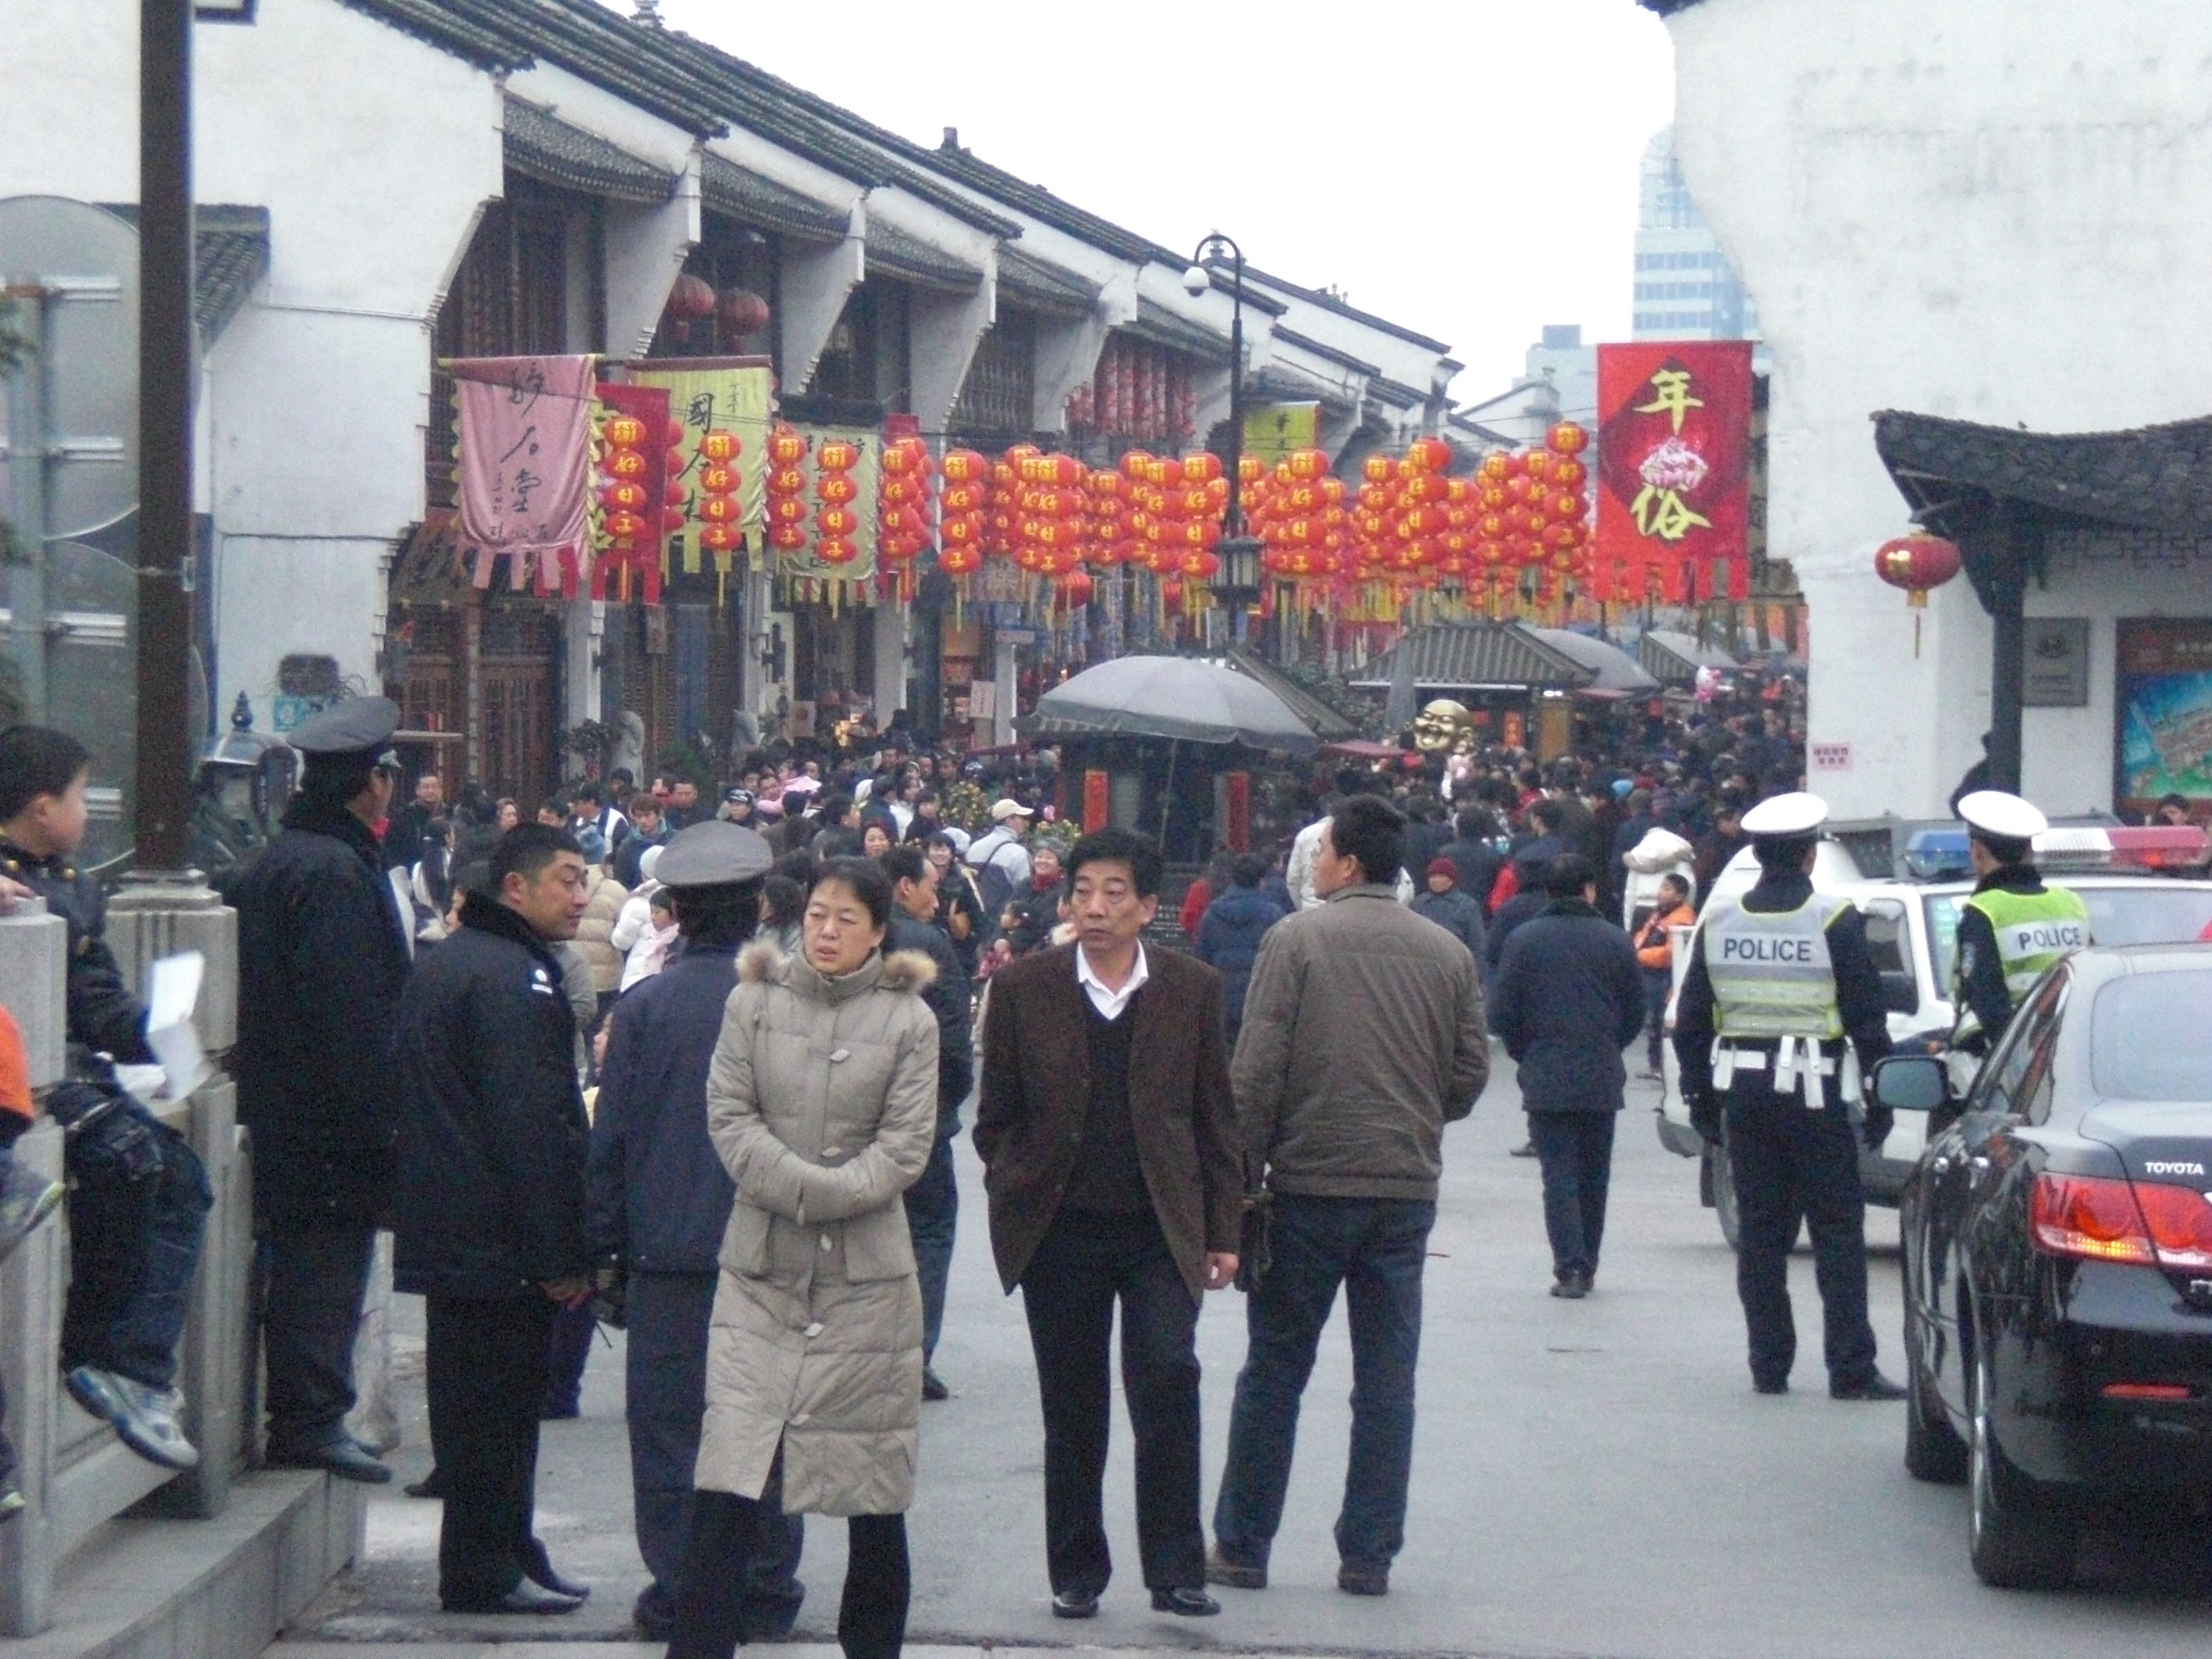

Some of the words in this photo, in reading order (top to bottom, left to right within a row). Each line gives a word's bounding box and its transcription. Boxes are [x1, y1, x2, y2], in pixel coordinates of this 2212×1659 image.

[614, 456, 638, 533] 好日子
[707, 470, 729, 544] 好日子
[825, 480, 847, 558] 好日子
[946, 490, 970, 568] 好日子
[1723, 938, 1812, 962] POLICE
[2018, 927, 2083, 950] POLICE
[2145, 1162, 2205, 1175] TOYOTA
